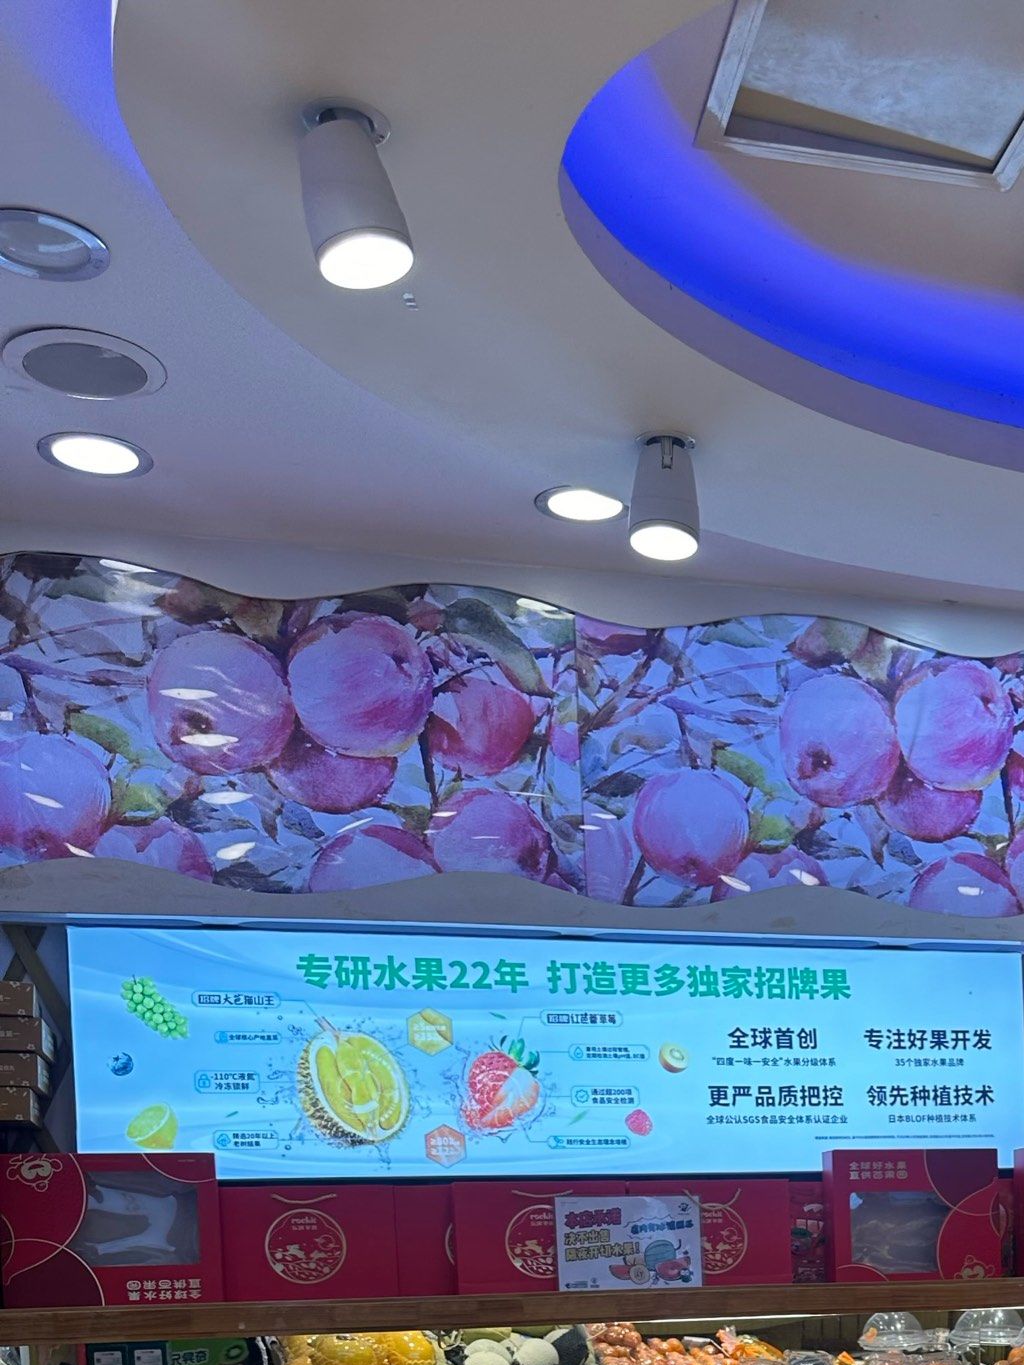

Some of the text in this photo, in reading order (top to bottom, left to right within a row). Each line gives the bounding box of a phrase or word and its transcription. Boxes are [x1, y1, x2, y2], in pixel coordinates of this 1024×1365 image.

[296, 953, 852, 1001] 专研水果22年 打造更多独家招牌果
[727, 1027, 993, 1051] 全球首创 专注好果开发
[707, 1084, 995, 1108] 更严品质把控 领先种植技术
